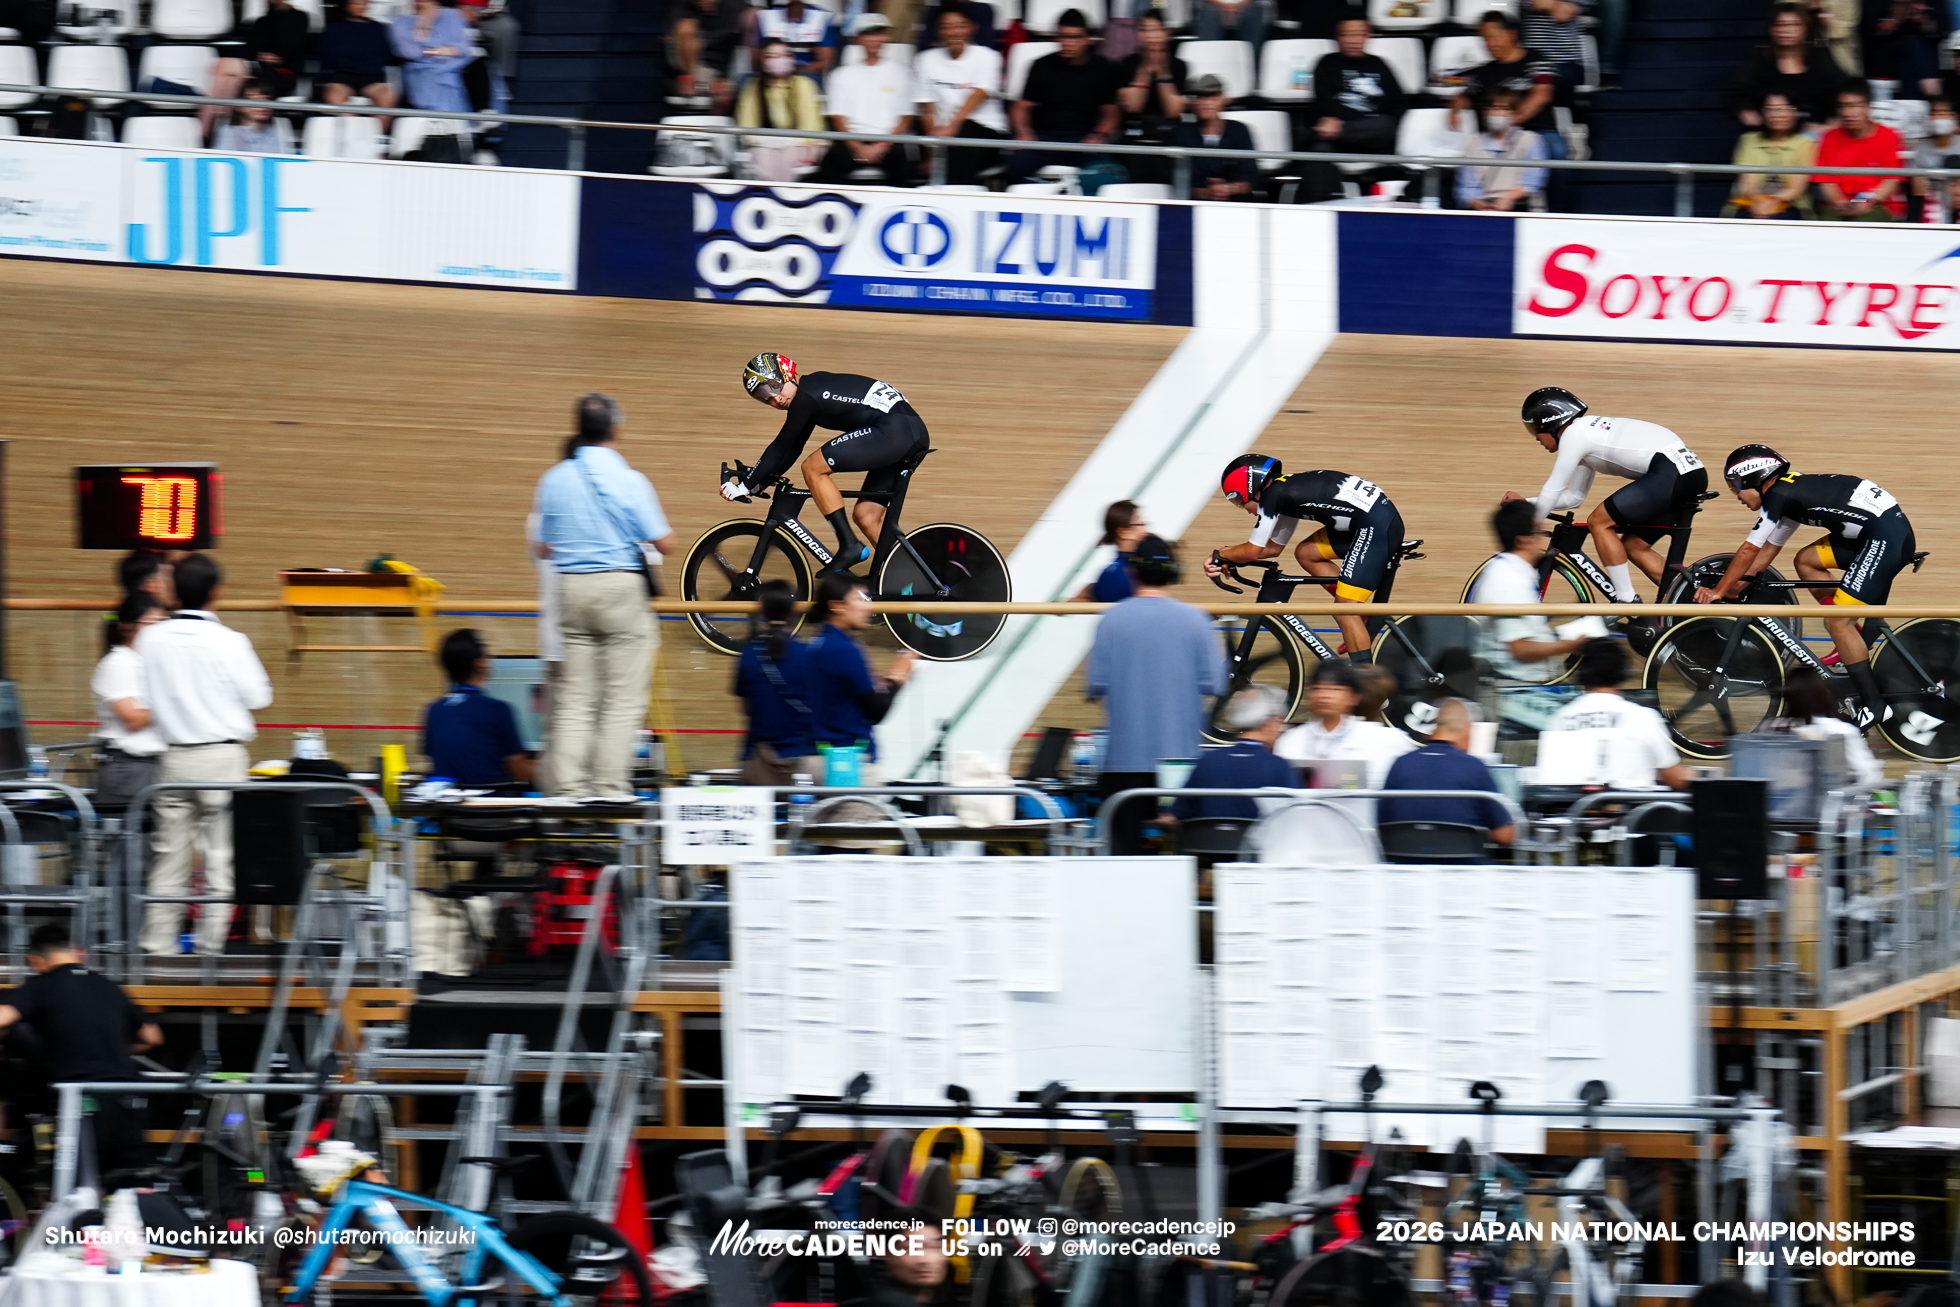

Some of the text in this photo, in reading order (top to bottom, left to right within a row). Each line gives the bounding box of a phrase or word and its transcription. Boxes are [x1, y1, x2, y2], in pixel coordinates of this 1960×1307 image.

[127, 157, 310, 265] JPF
[974, 211, 1130, 280] IZUMI
[1527, 243, 1955, 340] SOYO TYRE
[872, 384, 899, 400] 24
[830, 427, 872, 447] CASTELLI
[121, 476, 197, 539] 70
[1299, 502, 1355, 513] ANCHOR
[1353, 480, 1376, 497] 14
[1870, 487, 1883, 499] 4
[1807, 506, 1869, 521] ANCHOR
[1344, 527, 1368, 579] BRIDGESTONE
[1360, 526, 1374, 564] ANCHOR
[1850, 539, 1881, 593] BRIDGESTONE
